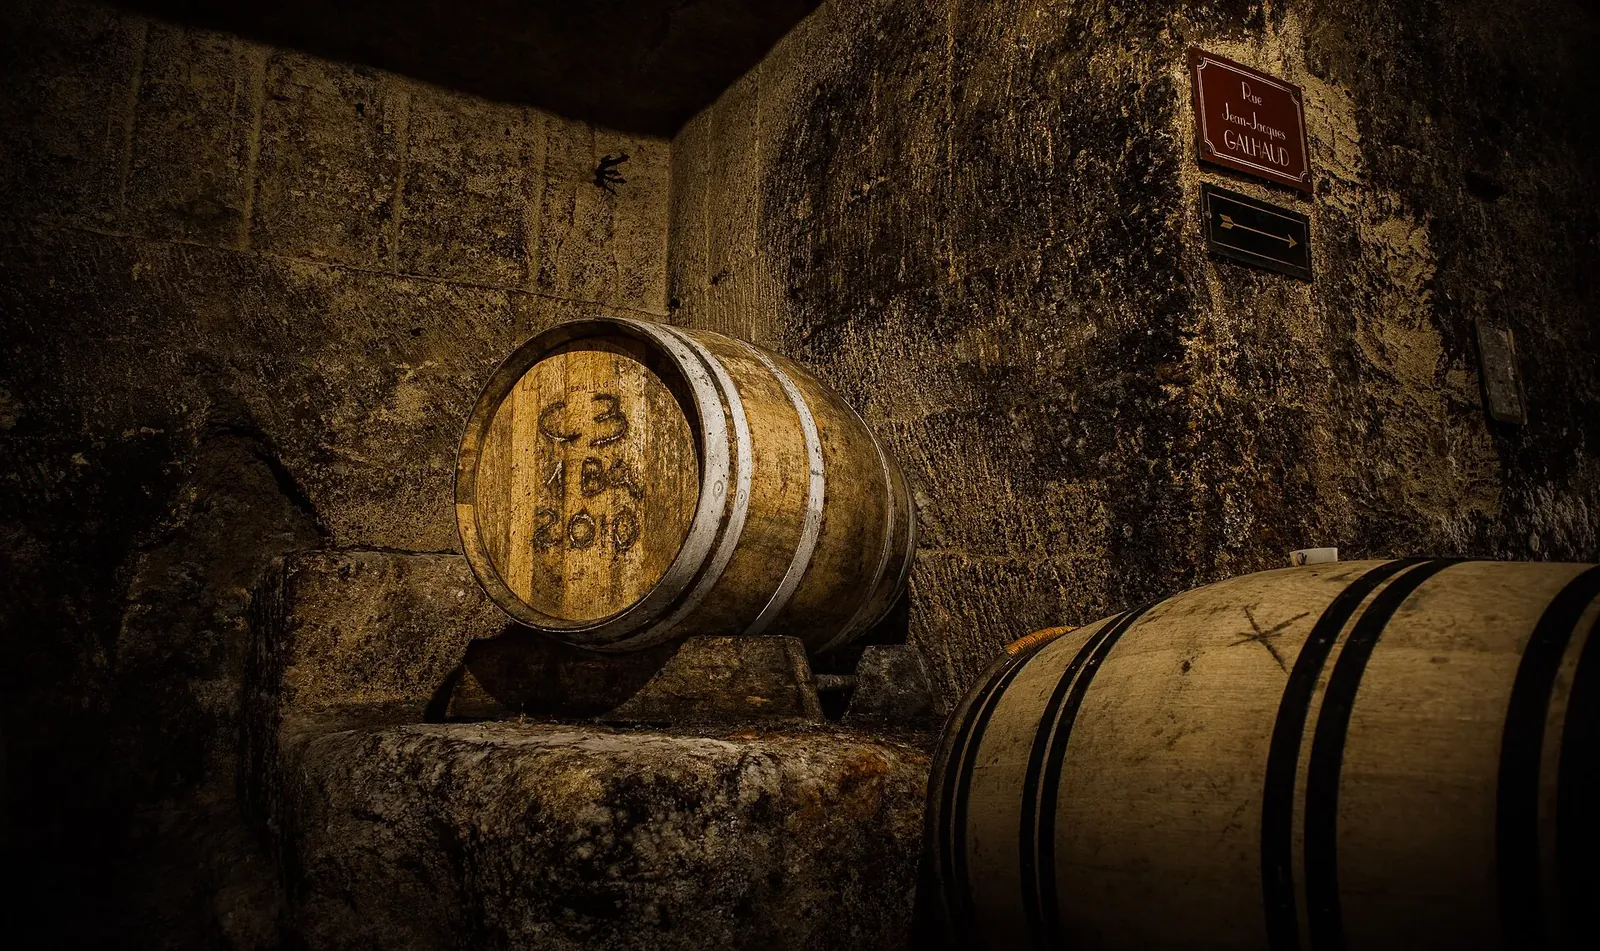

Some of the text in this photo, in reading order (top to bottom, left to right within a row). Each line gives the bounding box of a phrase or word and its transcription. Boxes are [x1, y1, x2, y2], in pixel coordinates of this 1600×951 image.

[1241, 81, 1263, 106] Rue
[1221, 102, 1287, 141] Jean-Jacques
[1223, 129, 1290, 167] GALHAUD
[533, 507, 640, 552] 2010
